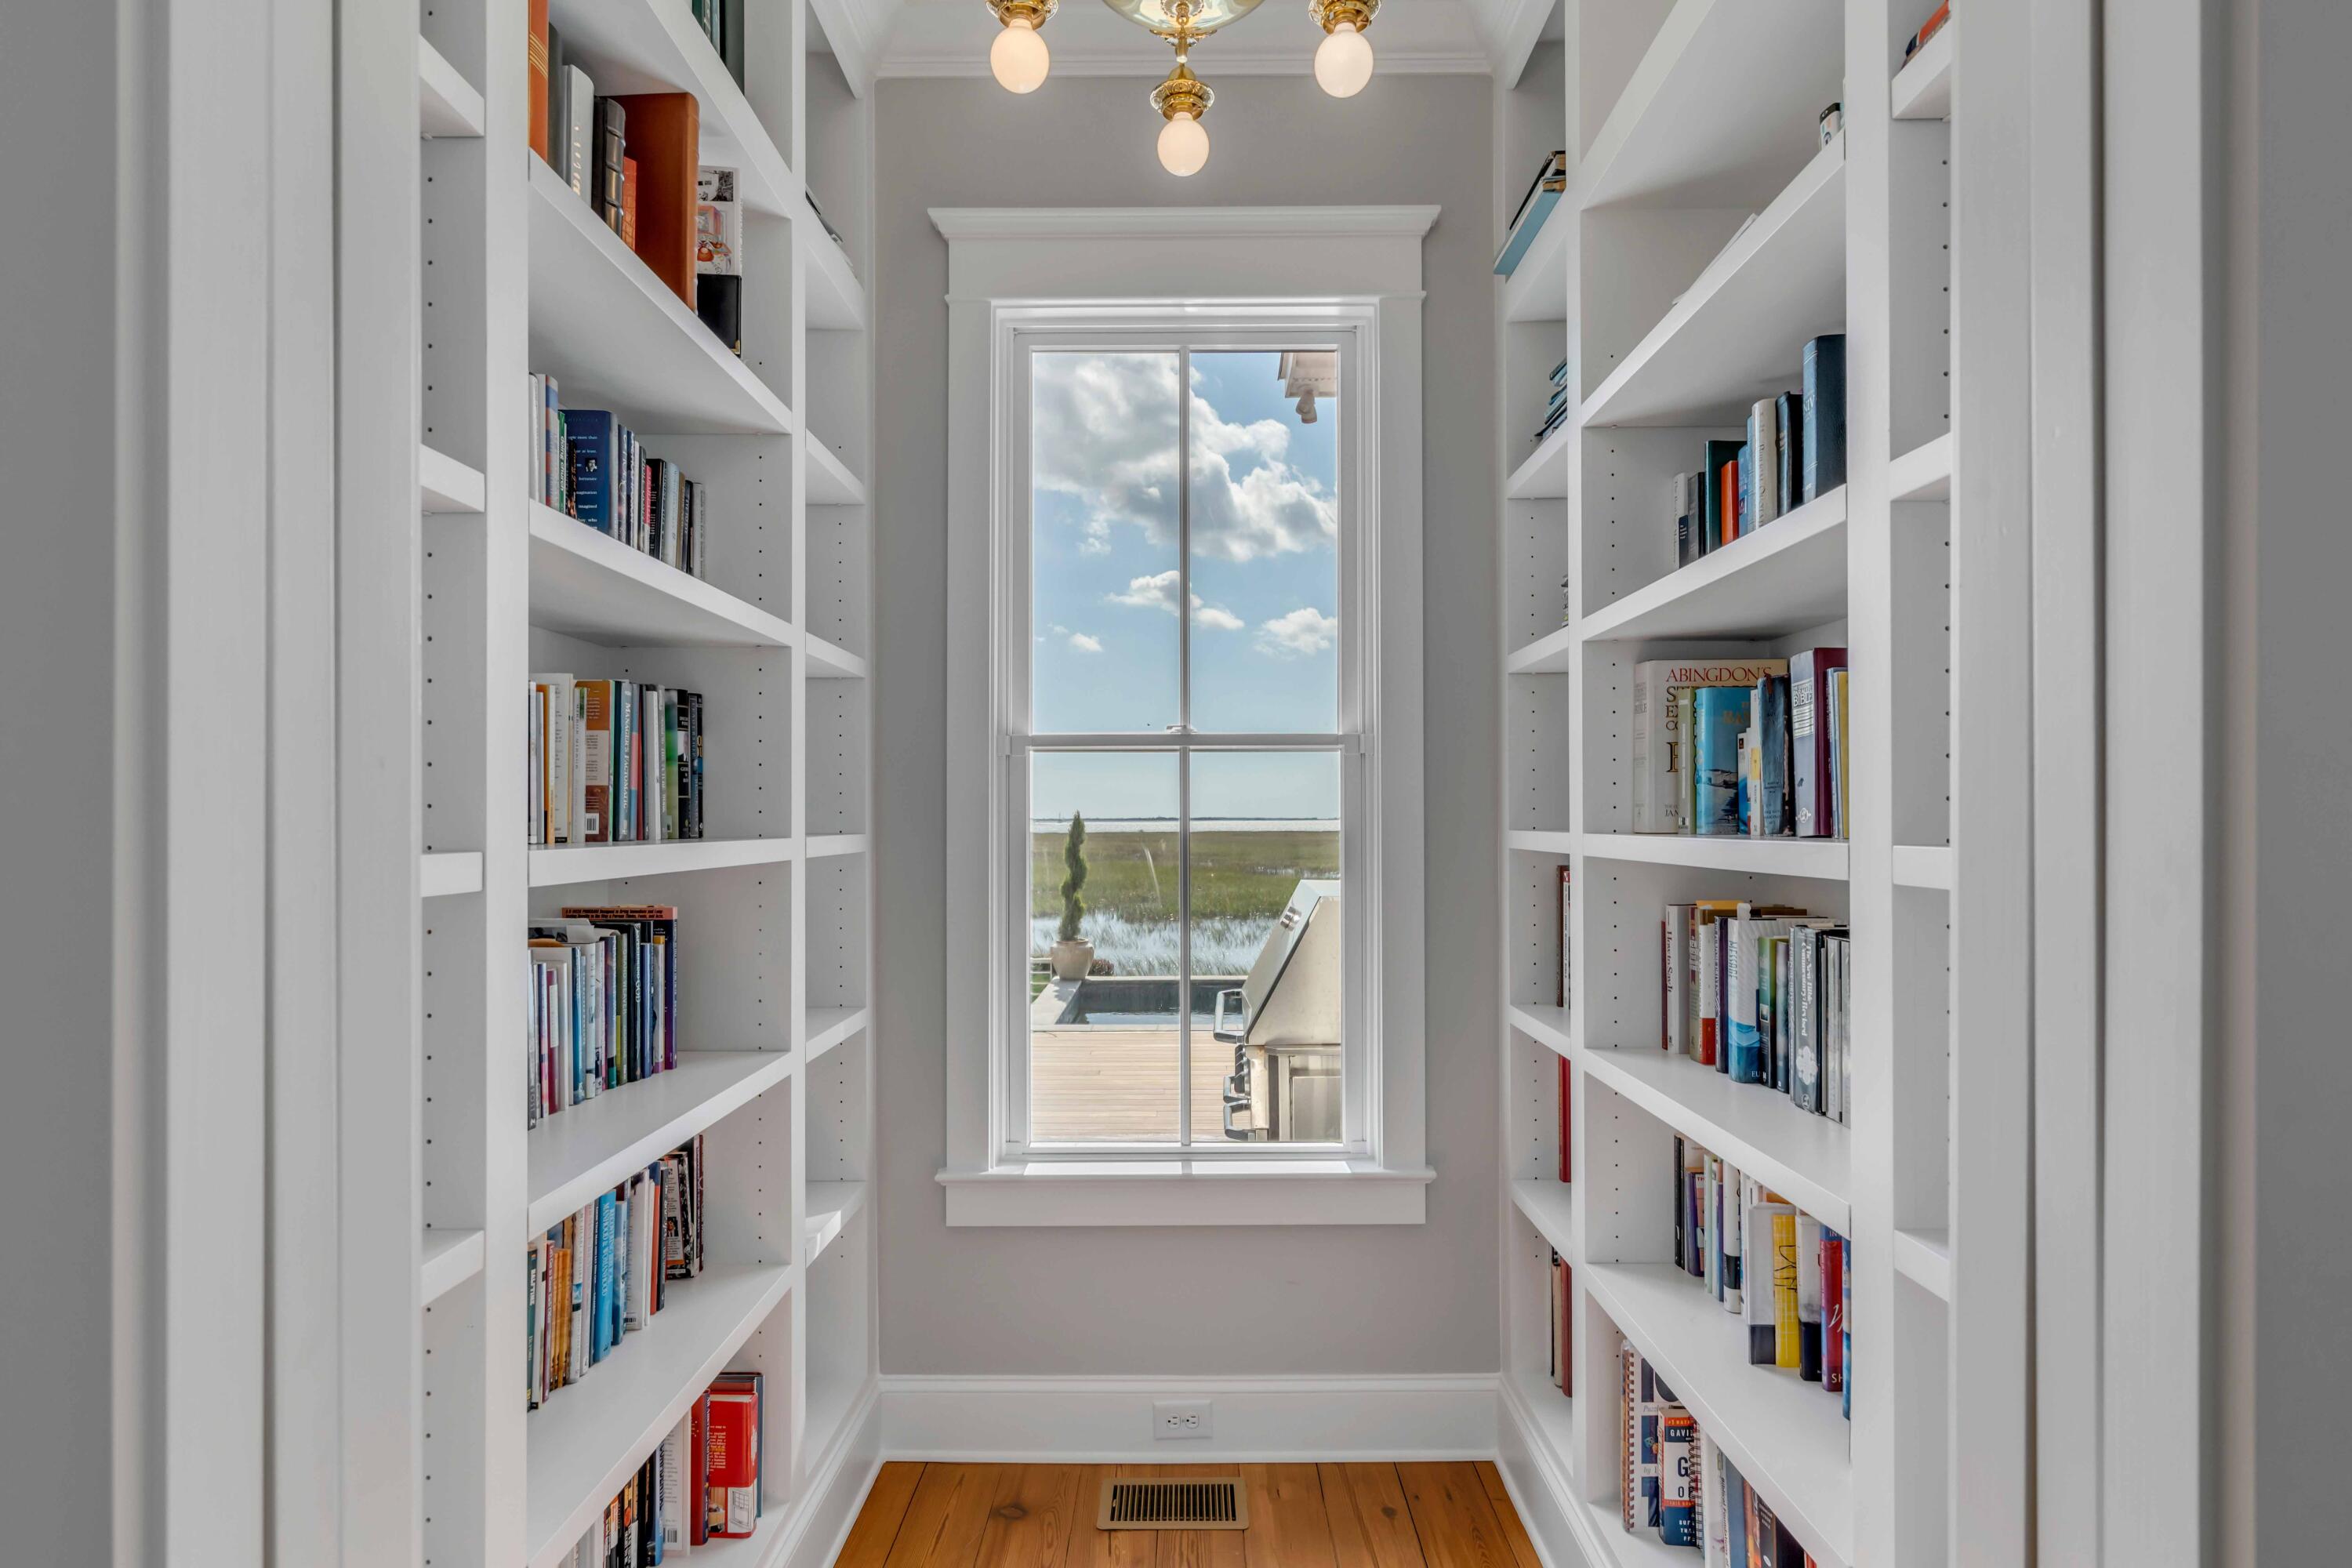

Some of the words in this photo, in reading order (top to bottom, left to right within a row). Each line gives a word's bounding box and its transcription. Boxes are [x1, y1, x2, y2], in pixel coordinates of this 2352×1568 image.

[1803, 394, 1815, 413] NIV
[1666, 666, 1772, 683] ABINGDON'S
[1793, 692, 1813, 707] BIBLE
[1729, 940, 1738, 980] MESSAGE
